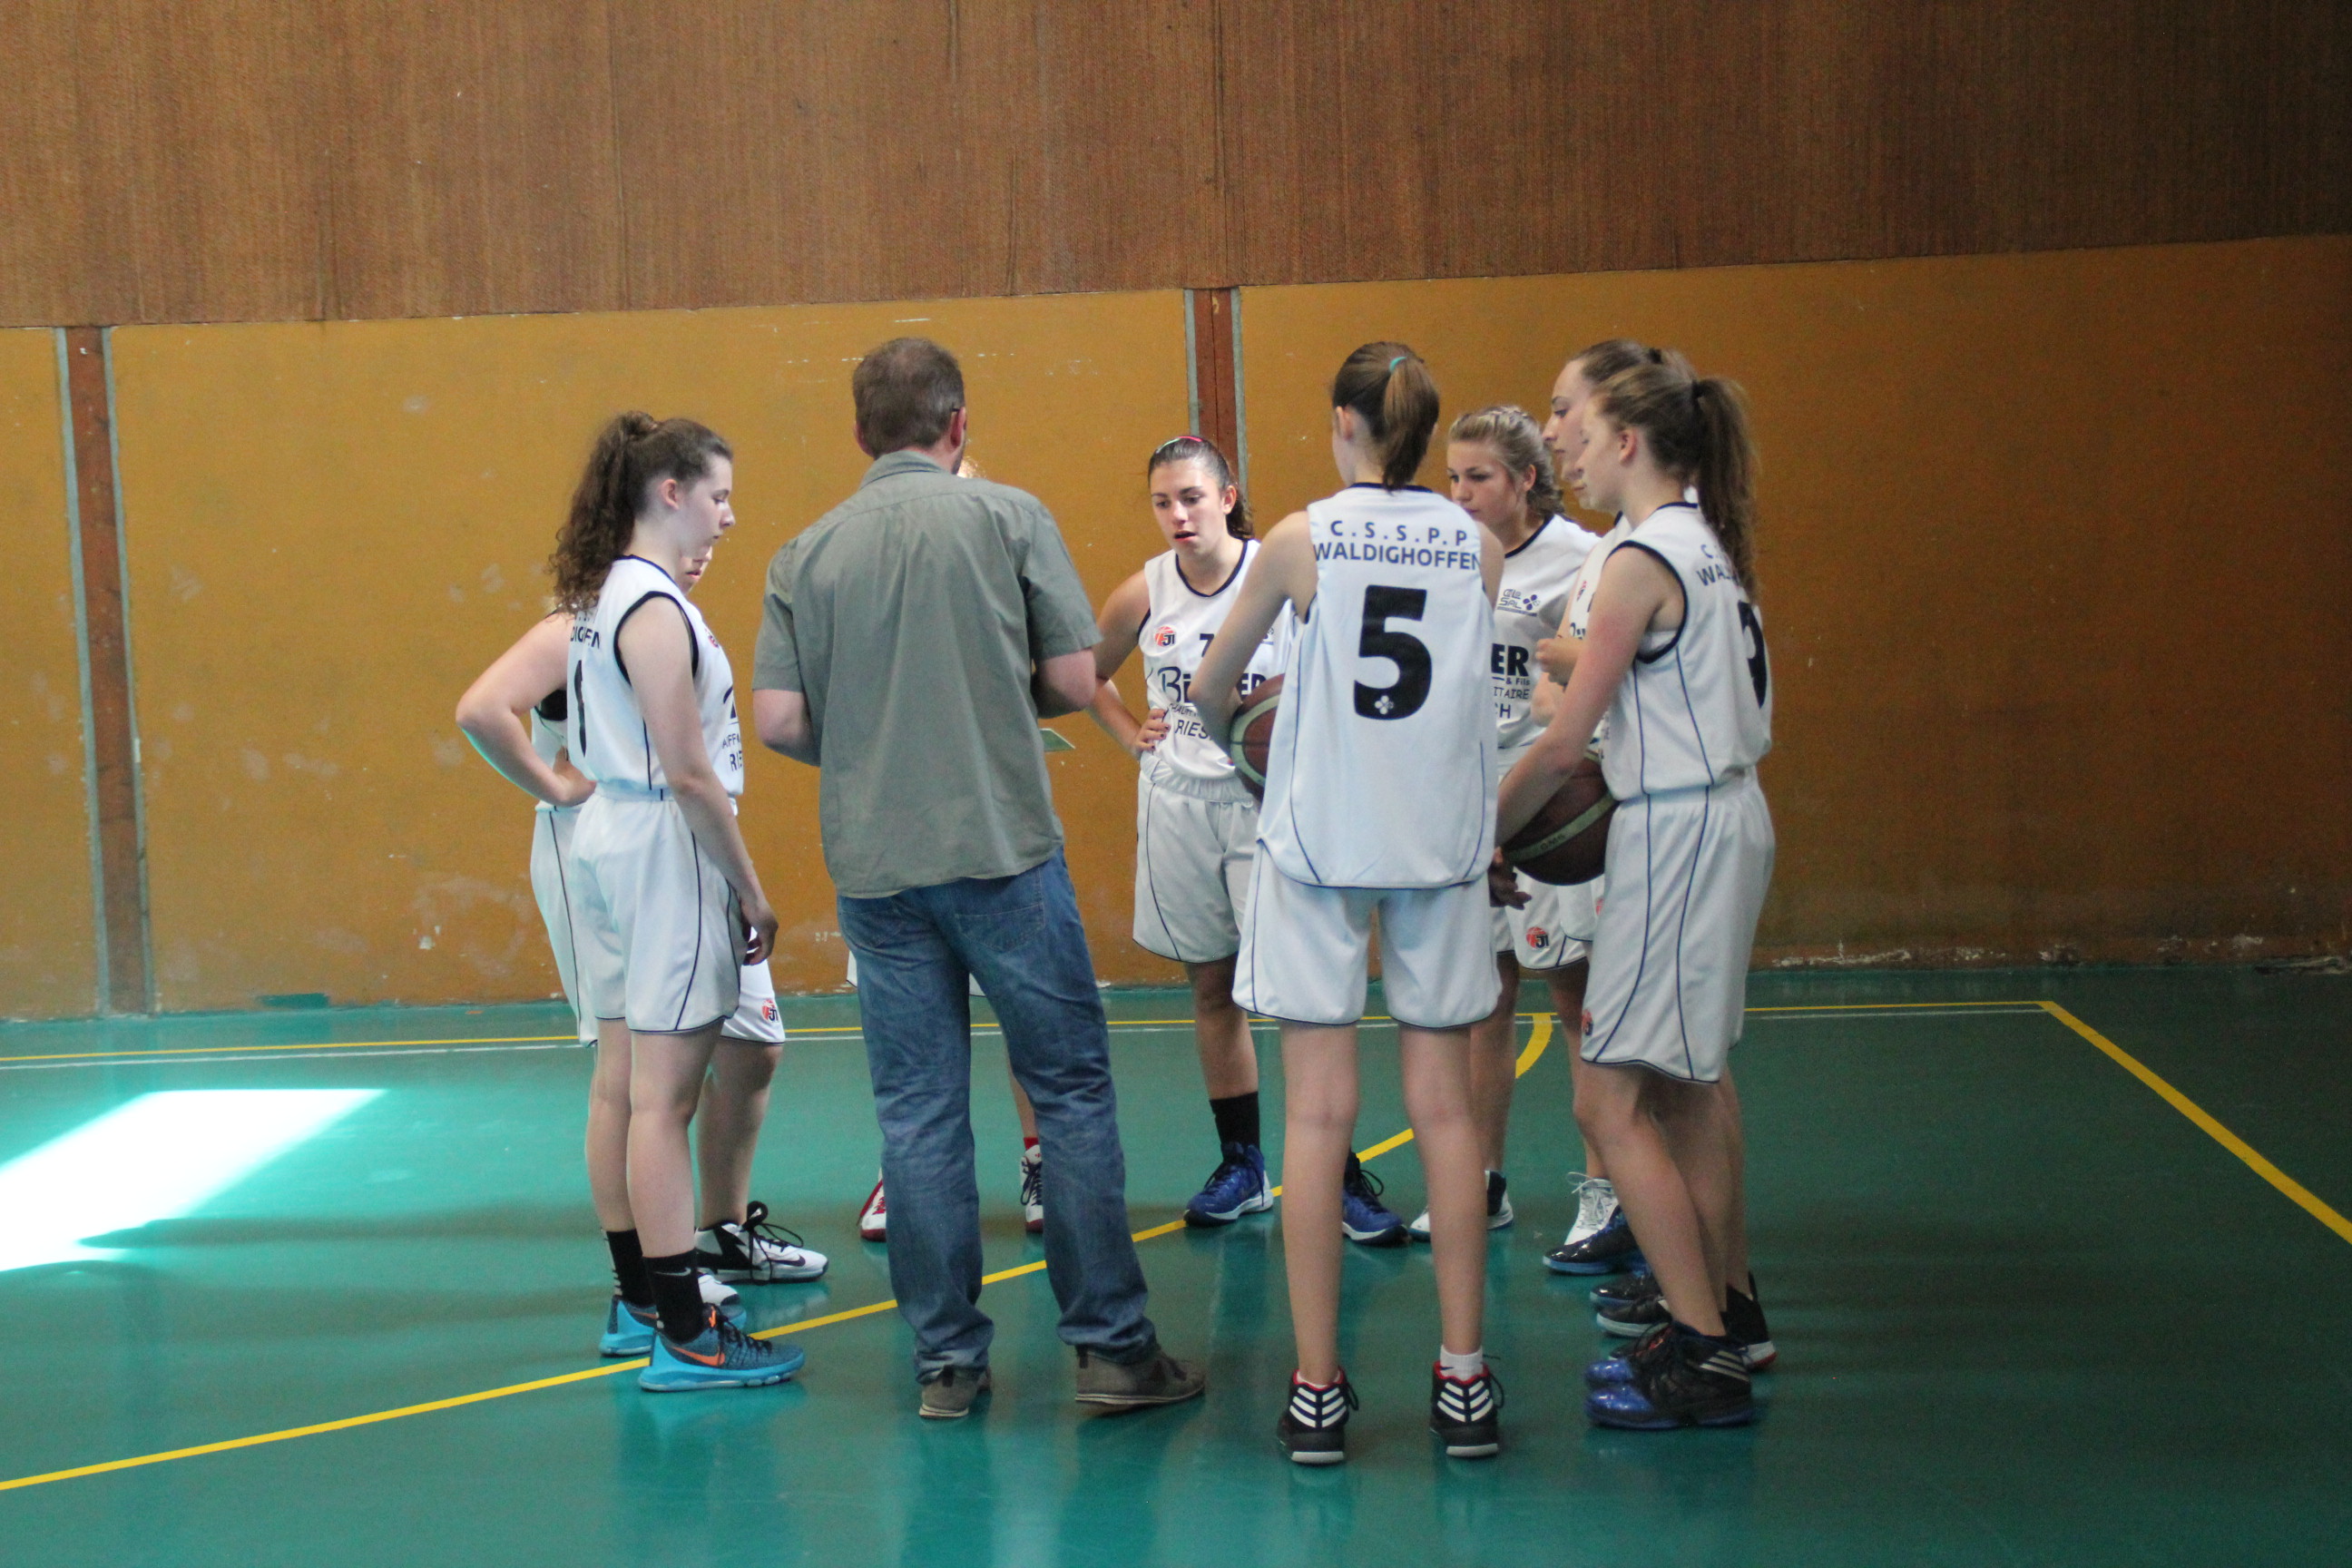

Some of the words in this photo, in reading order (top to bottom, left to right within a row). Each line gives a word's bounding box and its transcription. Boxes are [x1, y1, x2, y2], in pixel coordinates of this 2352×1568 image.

[1313, 541, 1480, 571] WALDIGHOFFEN
[1200, 633, 1215, 658] 7
[1354, 584, 1432, 720] 5
